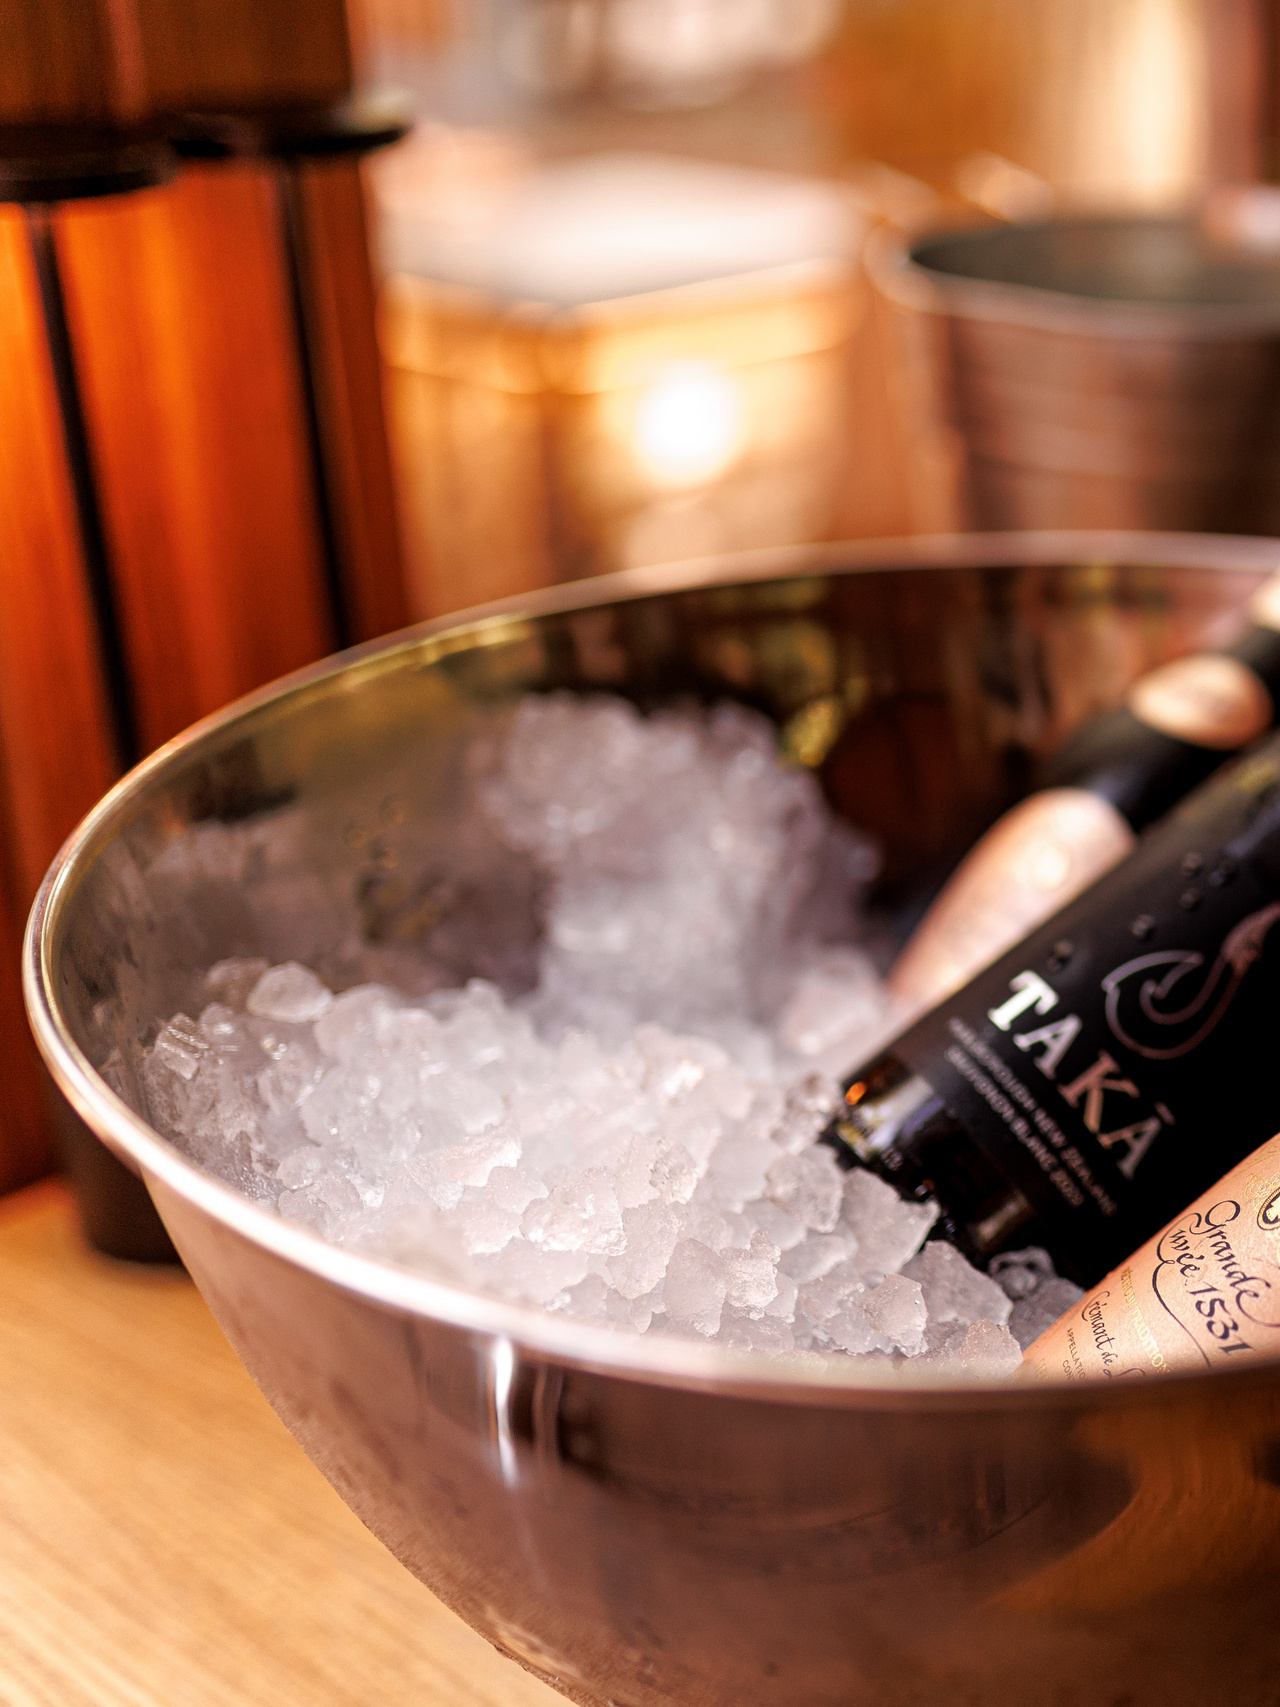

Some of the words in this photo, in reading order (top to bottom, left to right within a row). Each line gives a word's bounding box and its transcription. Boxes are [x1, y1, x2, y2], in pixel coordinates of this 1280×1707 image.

[987, 969, 1176, 1180] TAKĀ
[1066, 1328, 1087, 1380] APPELLATIO
[1082, 1290, 1117, 1351] Crémant
[1101, 1351, 1119, 1367] de
[1187, 1281, 1256, 1355] 1531
